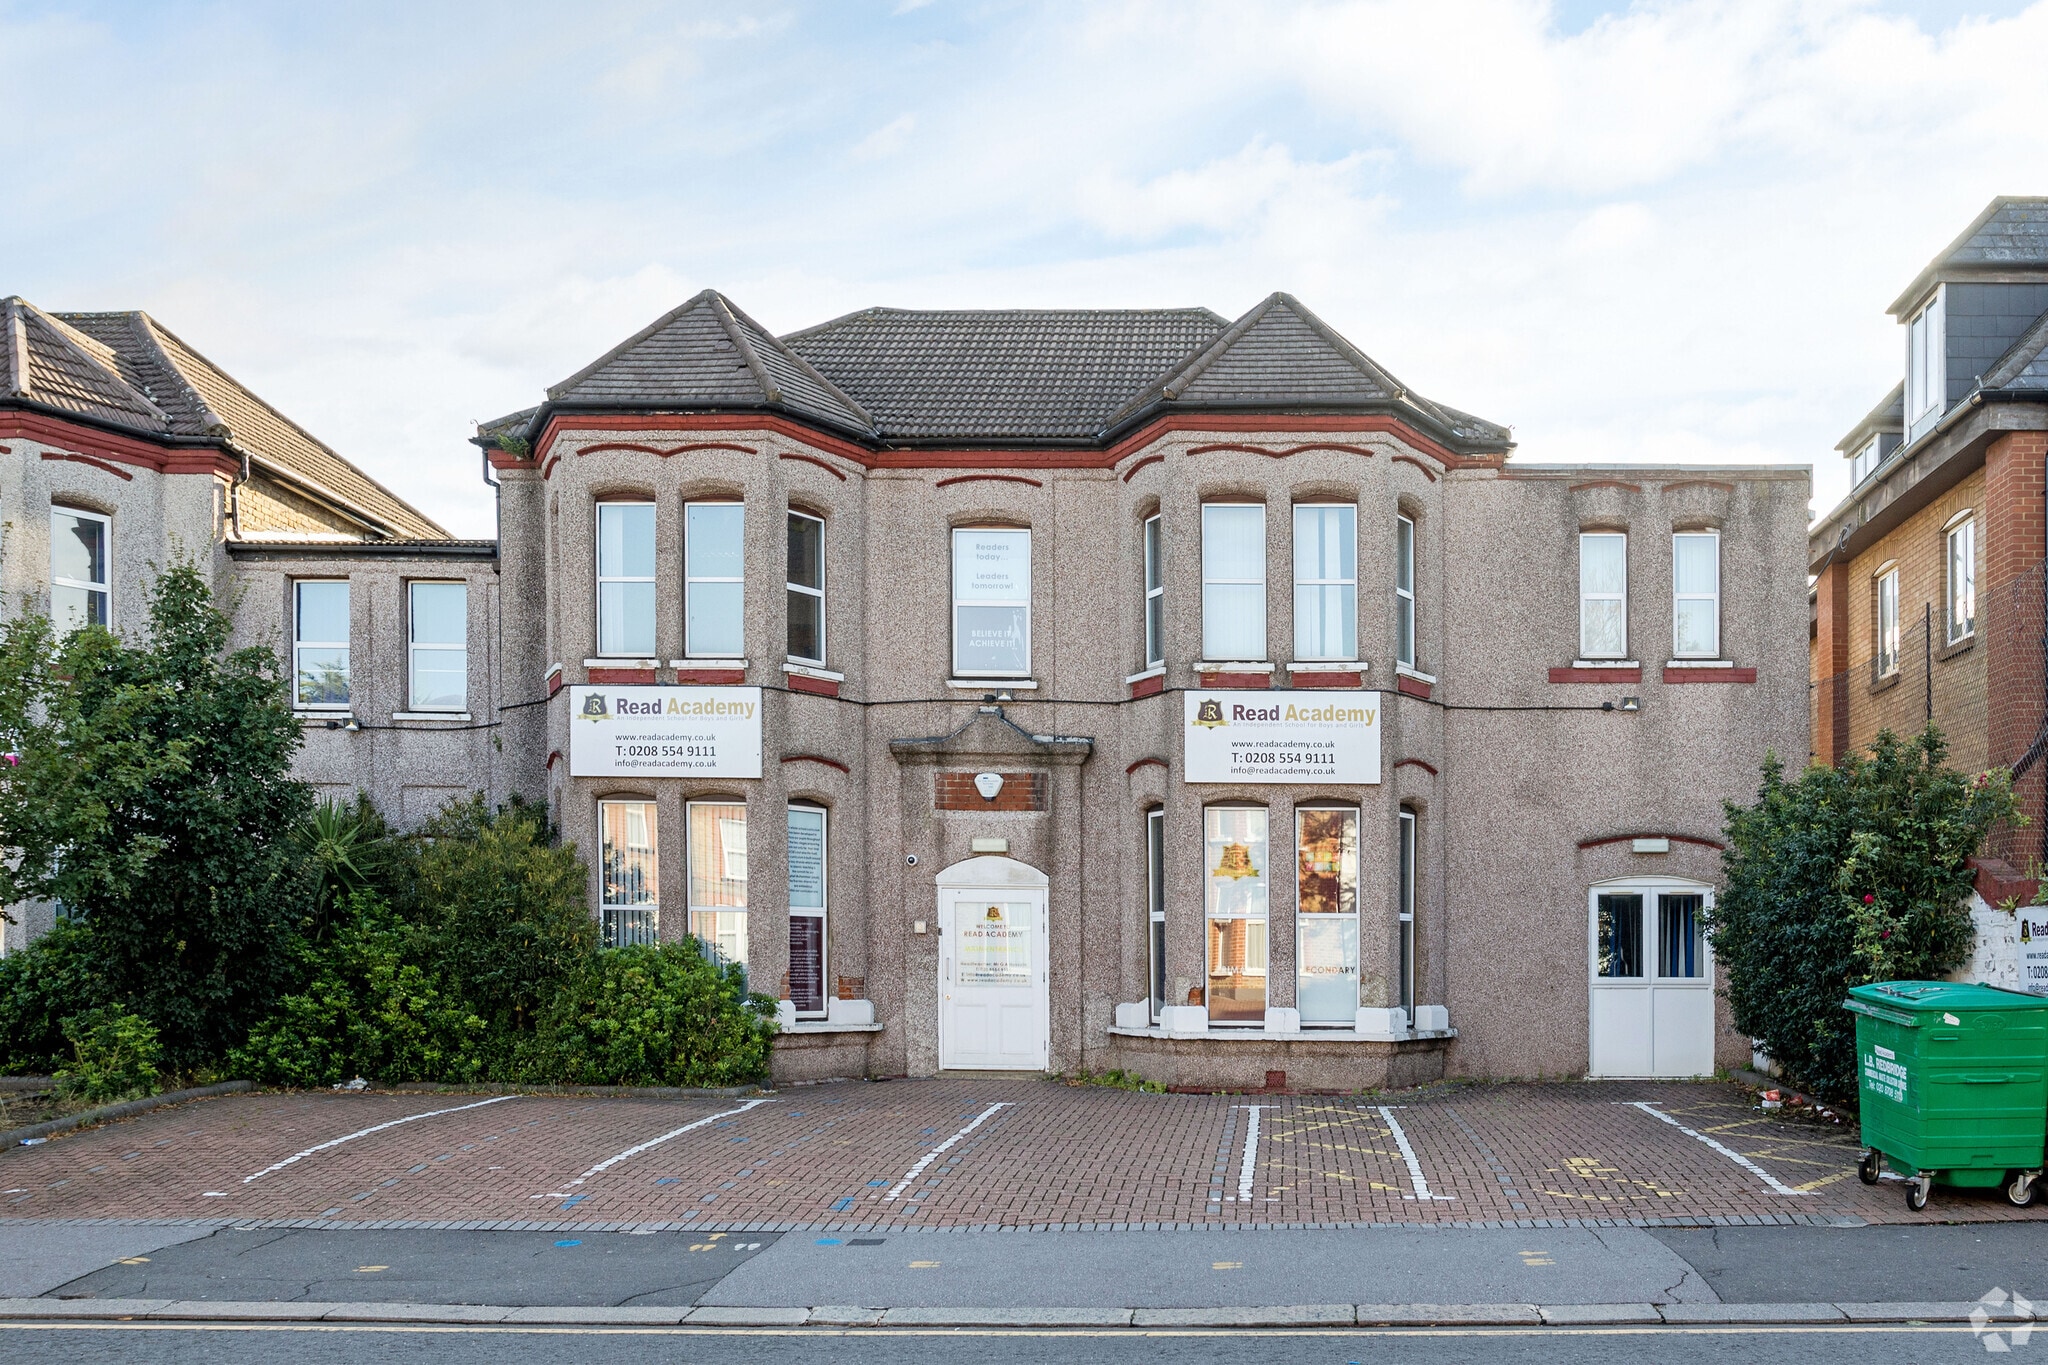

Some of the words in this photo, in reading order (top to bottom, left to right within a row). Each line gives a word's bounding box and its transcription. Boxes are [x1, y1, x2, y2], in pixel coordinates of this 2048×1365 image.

[975, 543, 1009, 551] Readers
[976, 553, 1008, 562] today...
[976, 572, 1008, 580] Leaders
[971, 582, 1014, 590] tomorrow!
[971, 629, 1002, 638] BELIEVE
[969, 639, 1005, 648] ACHIEVE
[616, 698, 662, 715] Read
[666, 697, 755, 720] Academy
[626, 715, 665, 723] Independent
[700, 715, 714, 723] Boys
[1232, 704, 1280, 721] Read
[1284, 703, 1377, 727] Academy
[1243, 722, 1283, 730] Independent
[1318, 722, 1334, 730] Boys
[615, 733, 716, 743] www.readacademy.co.uk
[1231, 740, 1335, 750] www.readacademy.co.uk
[615, 745, 627, 757] T:
[628, 745, 658, 757] 0208
[661, 745, 683, 757] 554
[686, 745, 717, 757] 9111
[1231, 752, 1243, 764] T:
[1245, 752, 1276, 764] 0208
[1279, 752, 1302, 764] 554
[1305, 752, 1336, 764] 9111
[614, 759, 717, 769] info@readacademy.co.uk
[1230, 766, 1336, 776] info@readacademy.co.uk
[963, 930, 984, 938] READ
[985, 930, 1023, 938] ACADEMY
[1305, 965, 1356, 974] ECONDARY
[1875, 1057, 1907, 1080] REDBRIDGE
